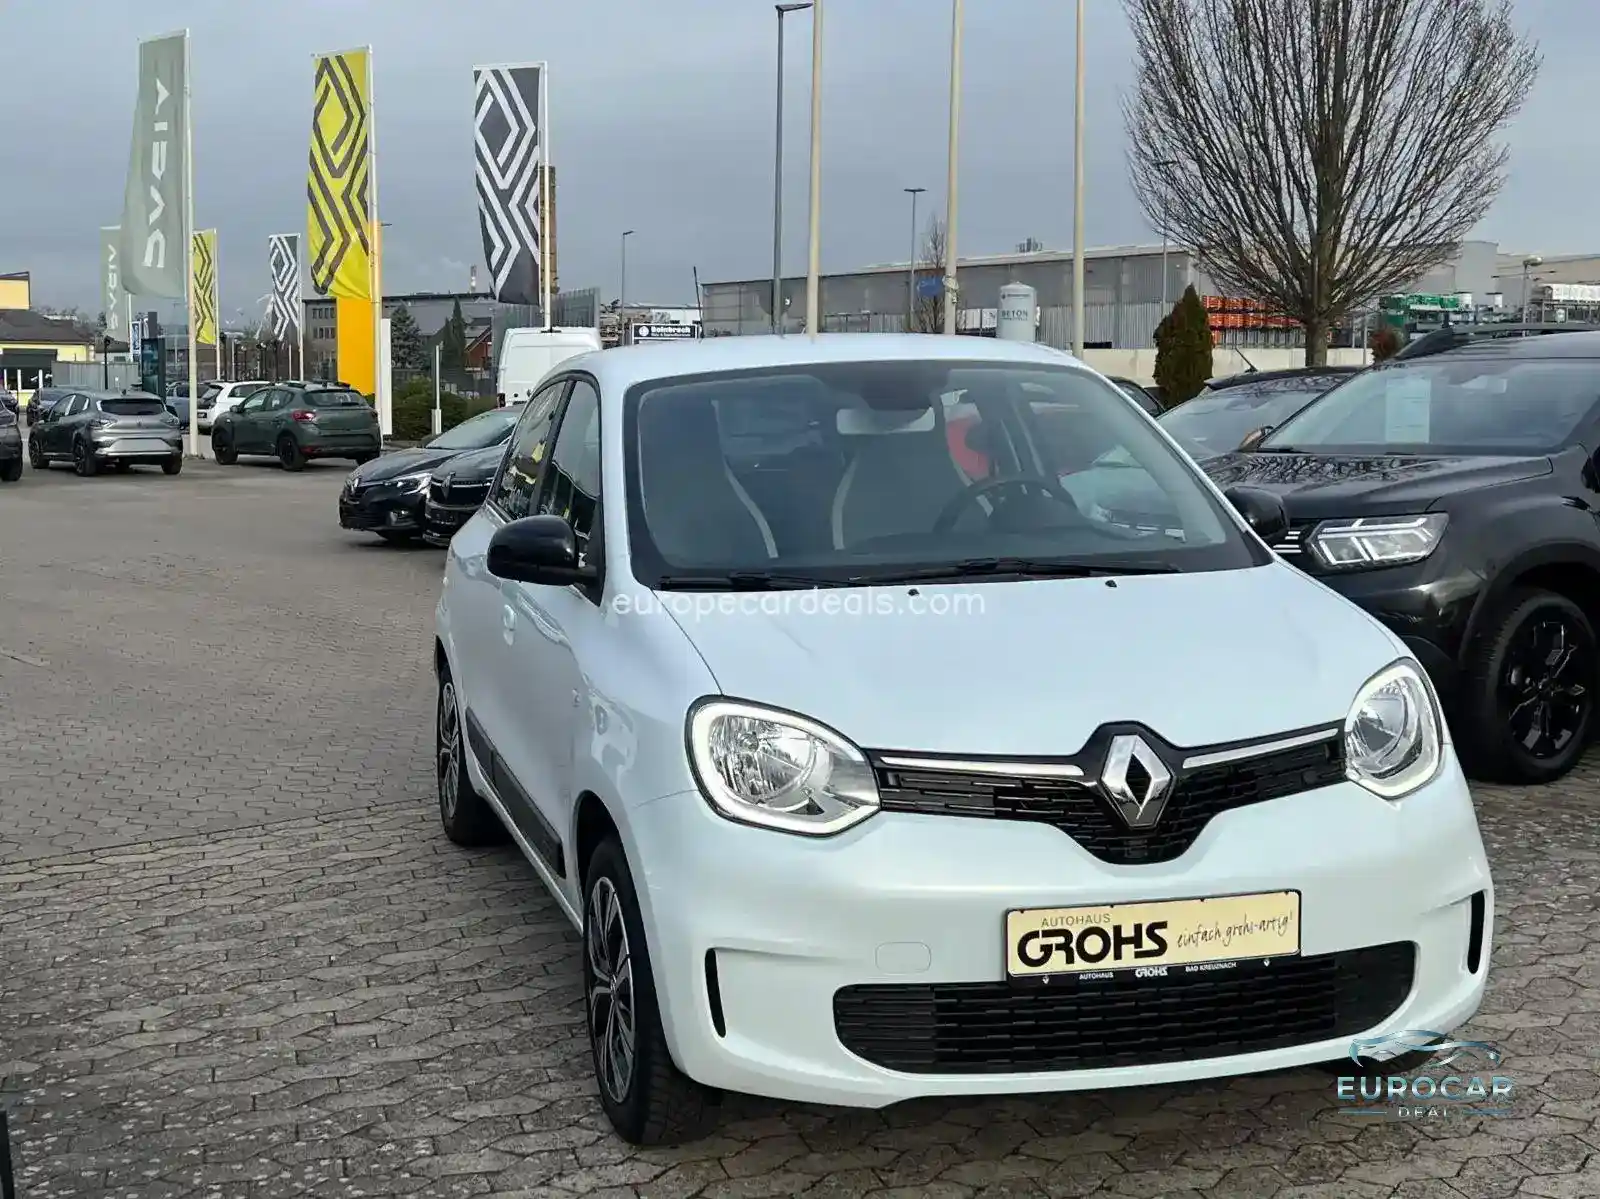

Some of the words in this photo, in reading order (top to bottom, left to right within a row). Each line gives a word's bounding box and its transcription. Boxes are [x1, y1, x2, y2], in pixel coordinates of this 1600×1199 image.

[1041, 913, 1111, 928] AUTOHAUS
[1017, 920, 1168, 968] GROHS
[1177, 921, 1222, 948] einfach
[1079, 971, 1114, 981] AUTOHAUS
[1135, 966, 1168, 979] GROHS
[1185, 964, 1198, 973] BAD
[1200, 961, 1237, 972] KREUZNACH
